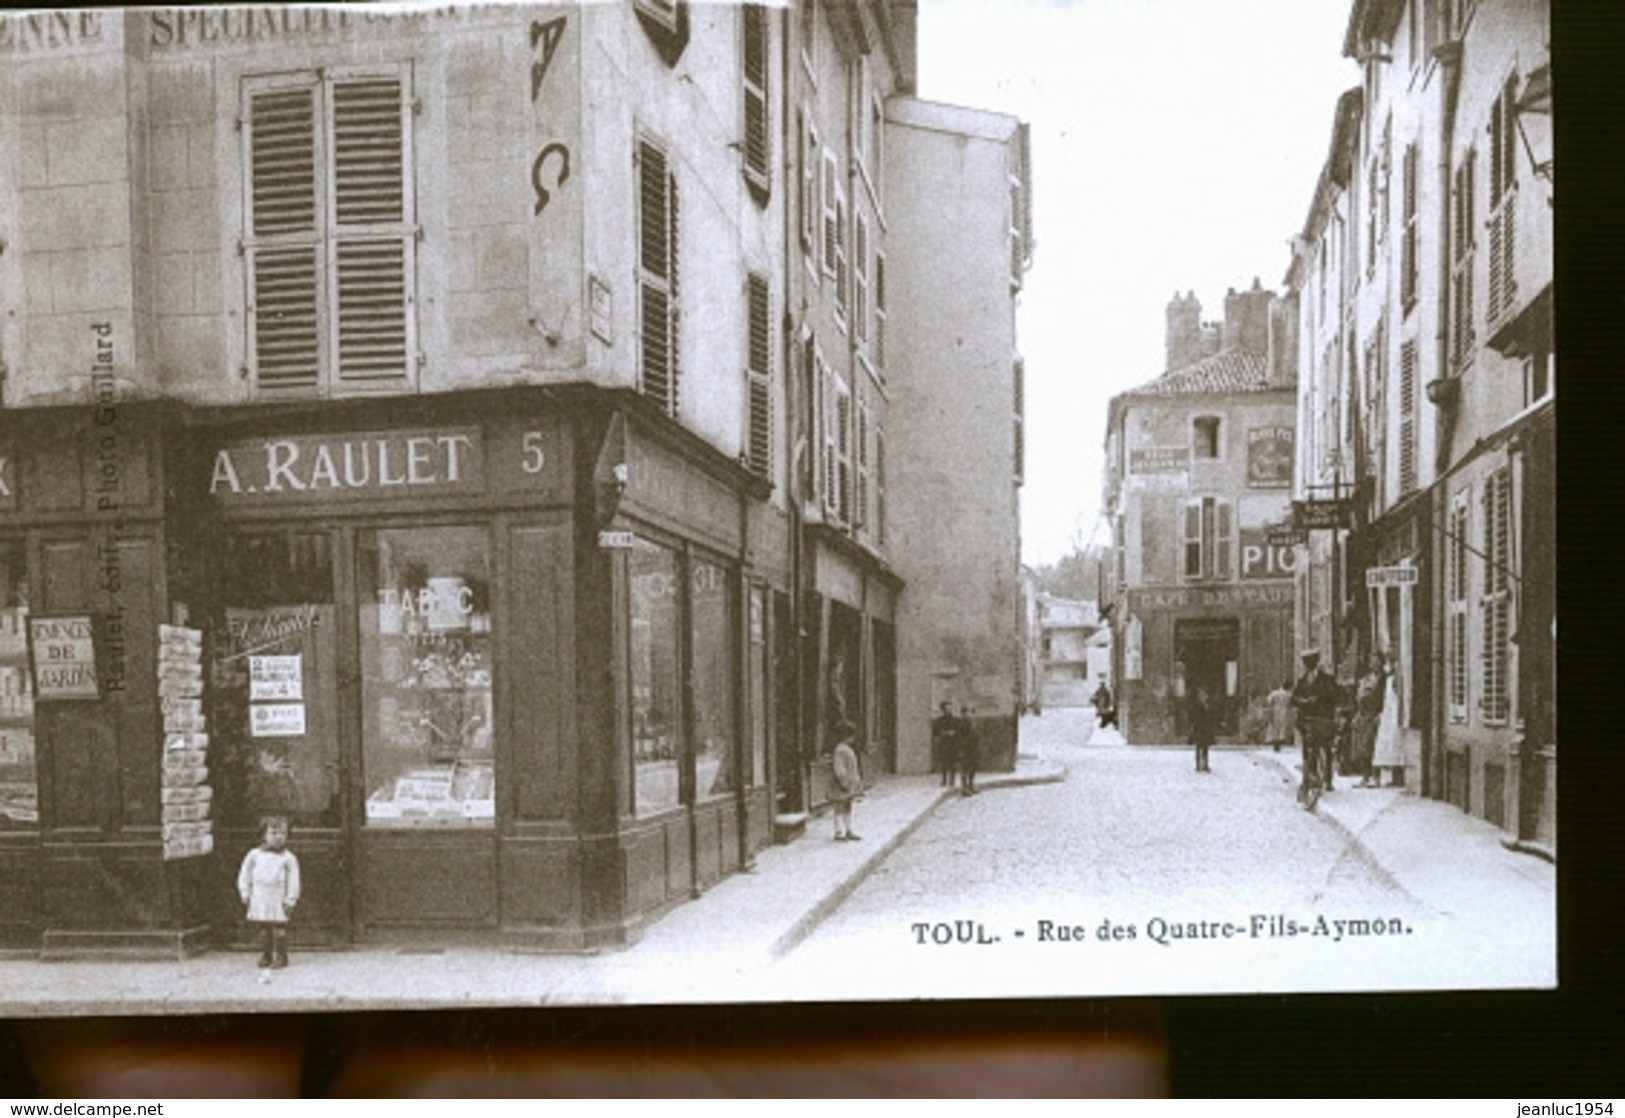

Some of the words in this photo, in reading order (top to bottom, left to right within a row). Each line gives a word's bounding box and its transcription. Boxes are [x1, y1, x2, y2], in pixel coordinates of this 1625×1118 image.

[263, 434, 475, 491] RAULET
[522, 432, 545, 473] 5
[378, 586, 474, 617] TABC
[48, 644, 76, 660] DE
